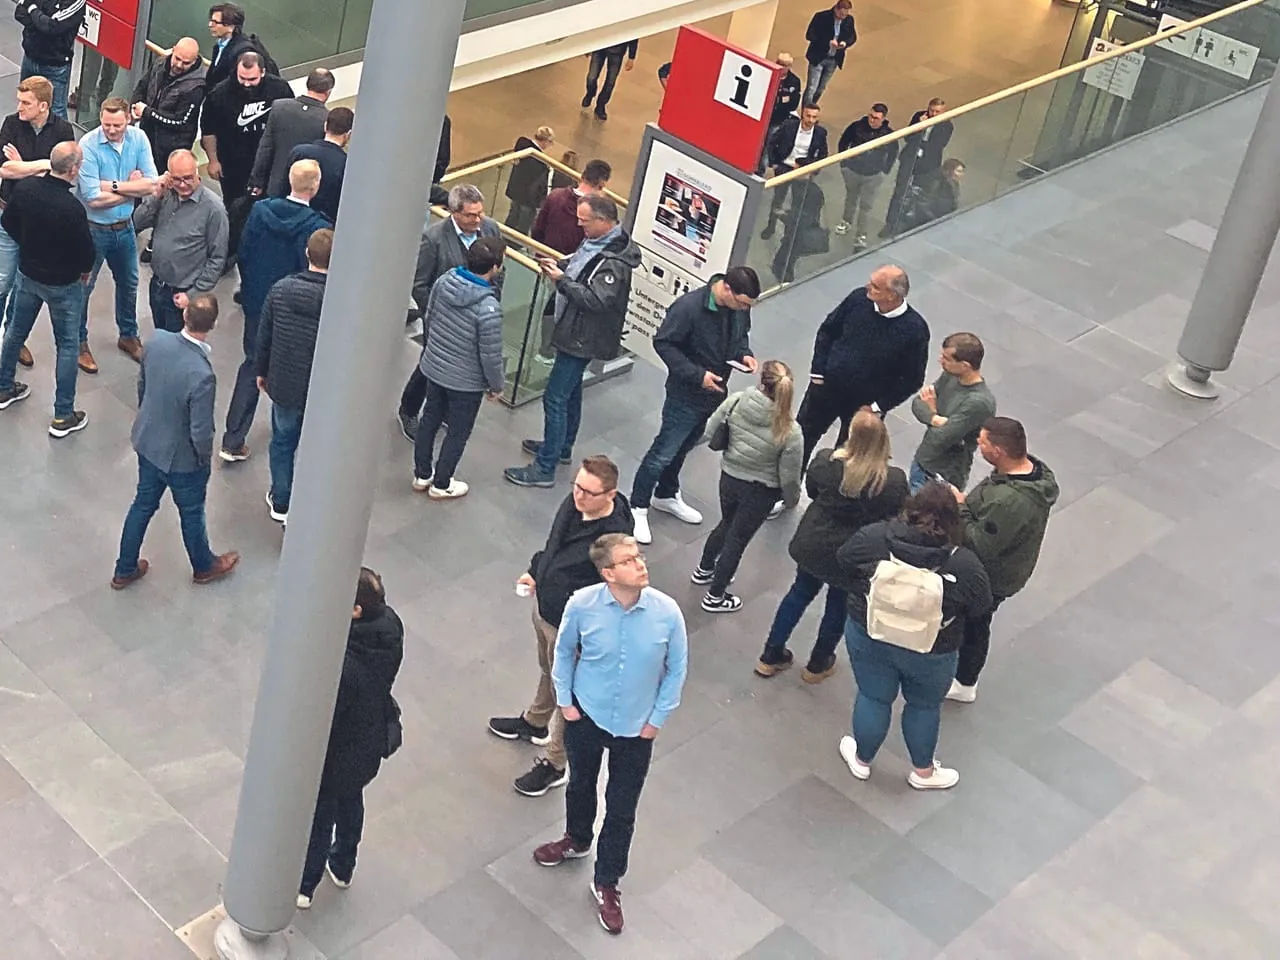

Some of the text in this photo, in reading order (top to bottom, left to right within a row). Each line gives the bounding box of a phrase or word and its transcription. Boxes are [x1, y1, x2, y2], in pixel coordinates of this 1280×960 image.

[88, 8, 100, 22] WC
[242, 100, 266, 117] NIKE
[636, 302, 651, 314] den
